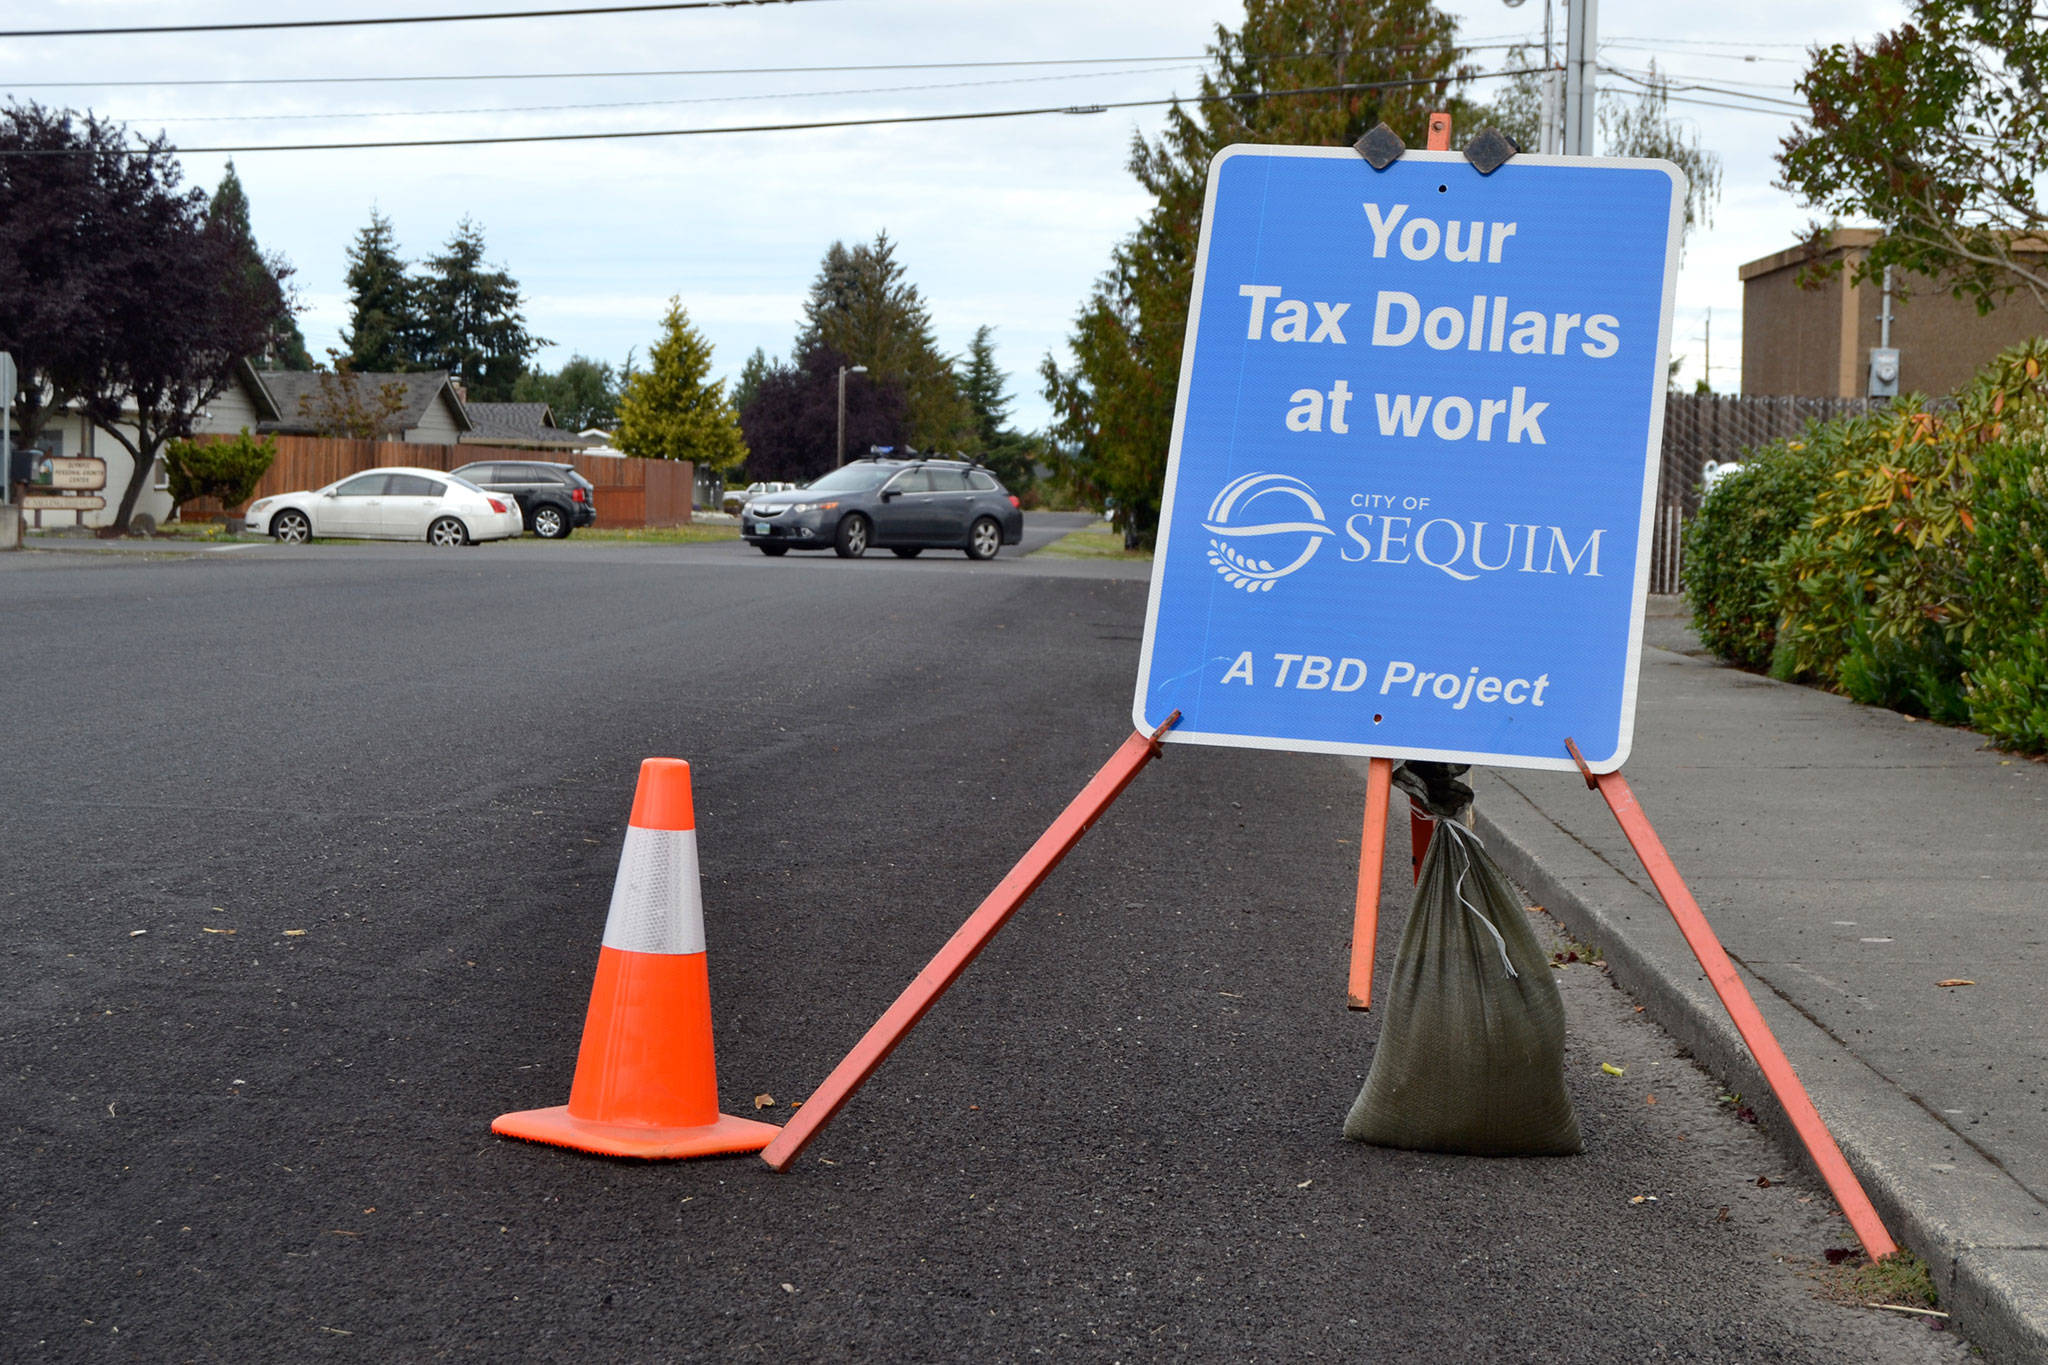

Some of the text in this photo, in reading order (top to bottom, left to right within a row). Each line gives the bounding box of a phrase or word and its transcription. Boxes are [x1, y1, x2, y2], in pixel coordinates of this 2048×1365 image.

[1362, 203, 1517, 264] Your
[1239, 284, 1620, 359] Tax Dollars
[1285, 379, 1550, 445] at work
[1350, 493, 1431, 511] CITY OF
[1340, 513, 1607, 582] SEQUIM
[1220, 651, 1550, 710] A TBD Project
